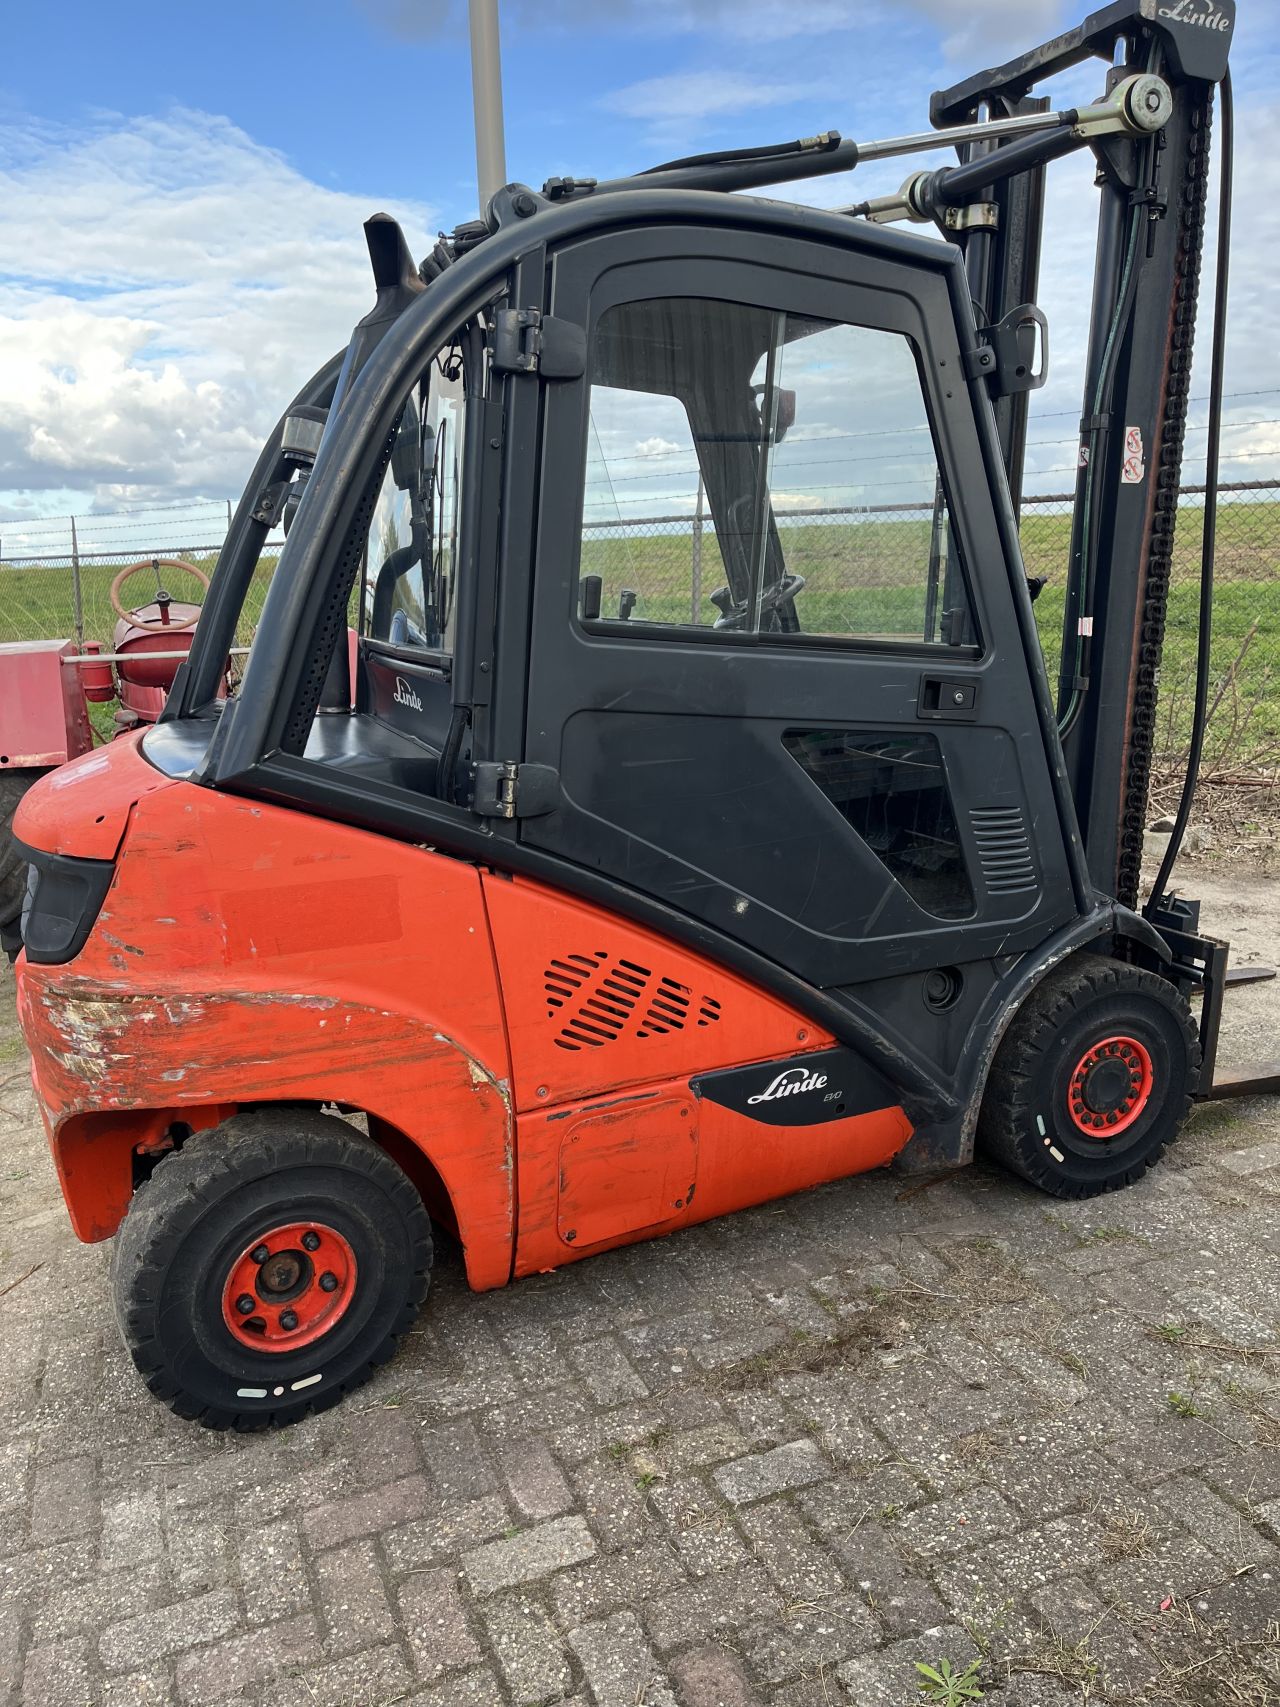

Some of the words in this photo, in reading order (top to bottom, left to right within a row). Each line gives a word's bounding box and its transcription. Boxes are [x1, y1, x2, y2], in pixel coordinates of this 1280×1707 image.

[1158, 0, 1229, 32] Linde
[394, 676, 424, 712] Linde
[747, 1068, 828, 1104] Linde
[823, 1091, 843, 1102] EVO
